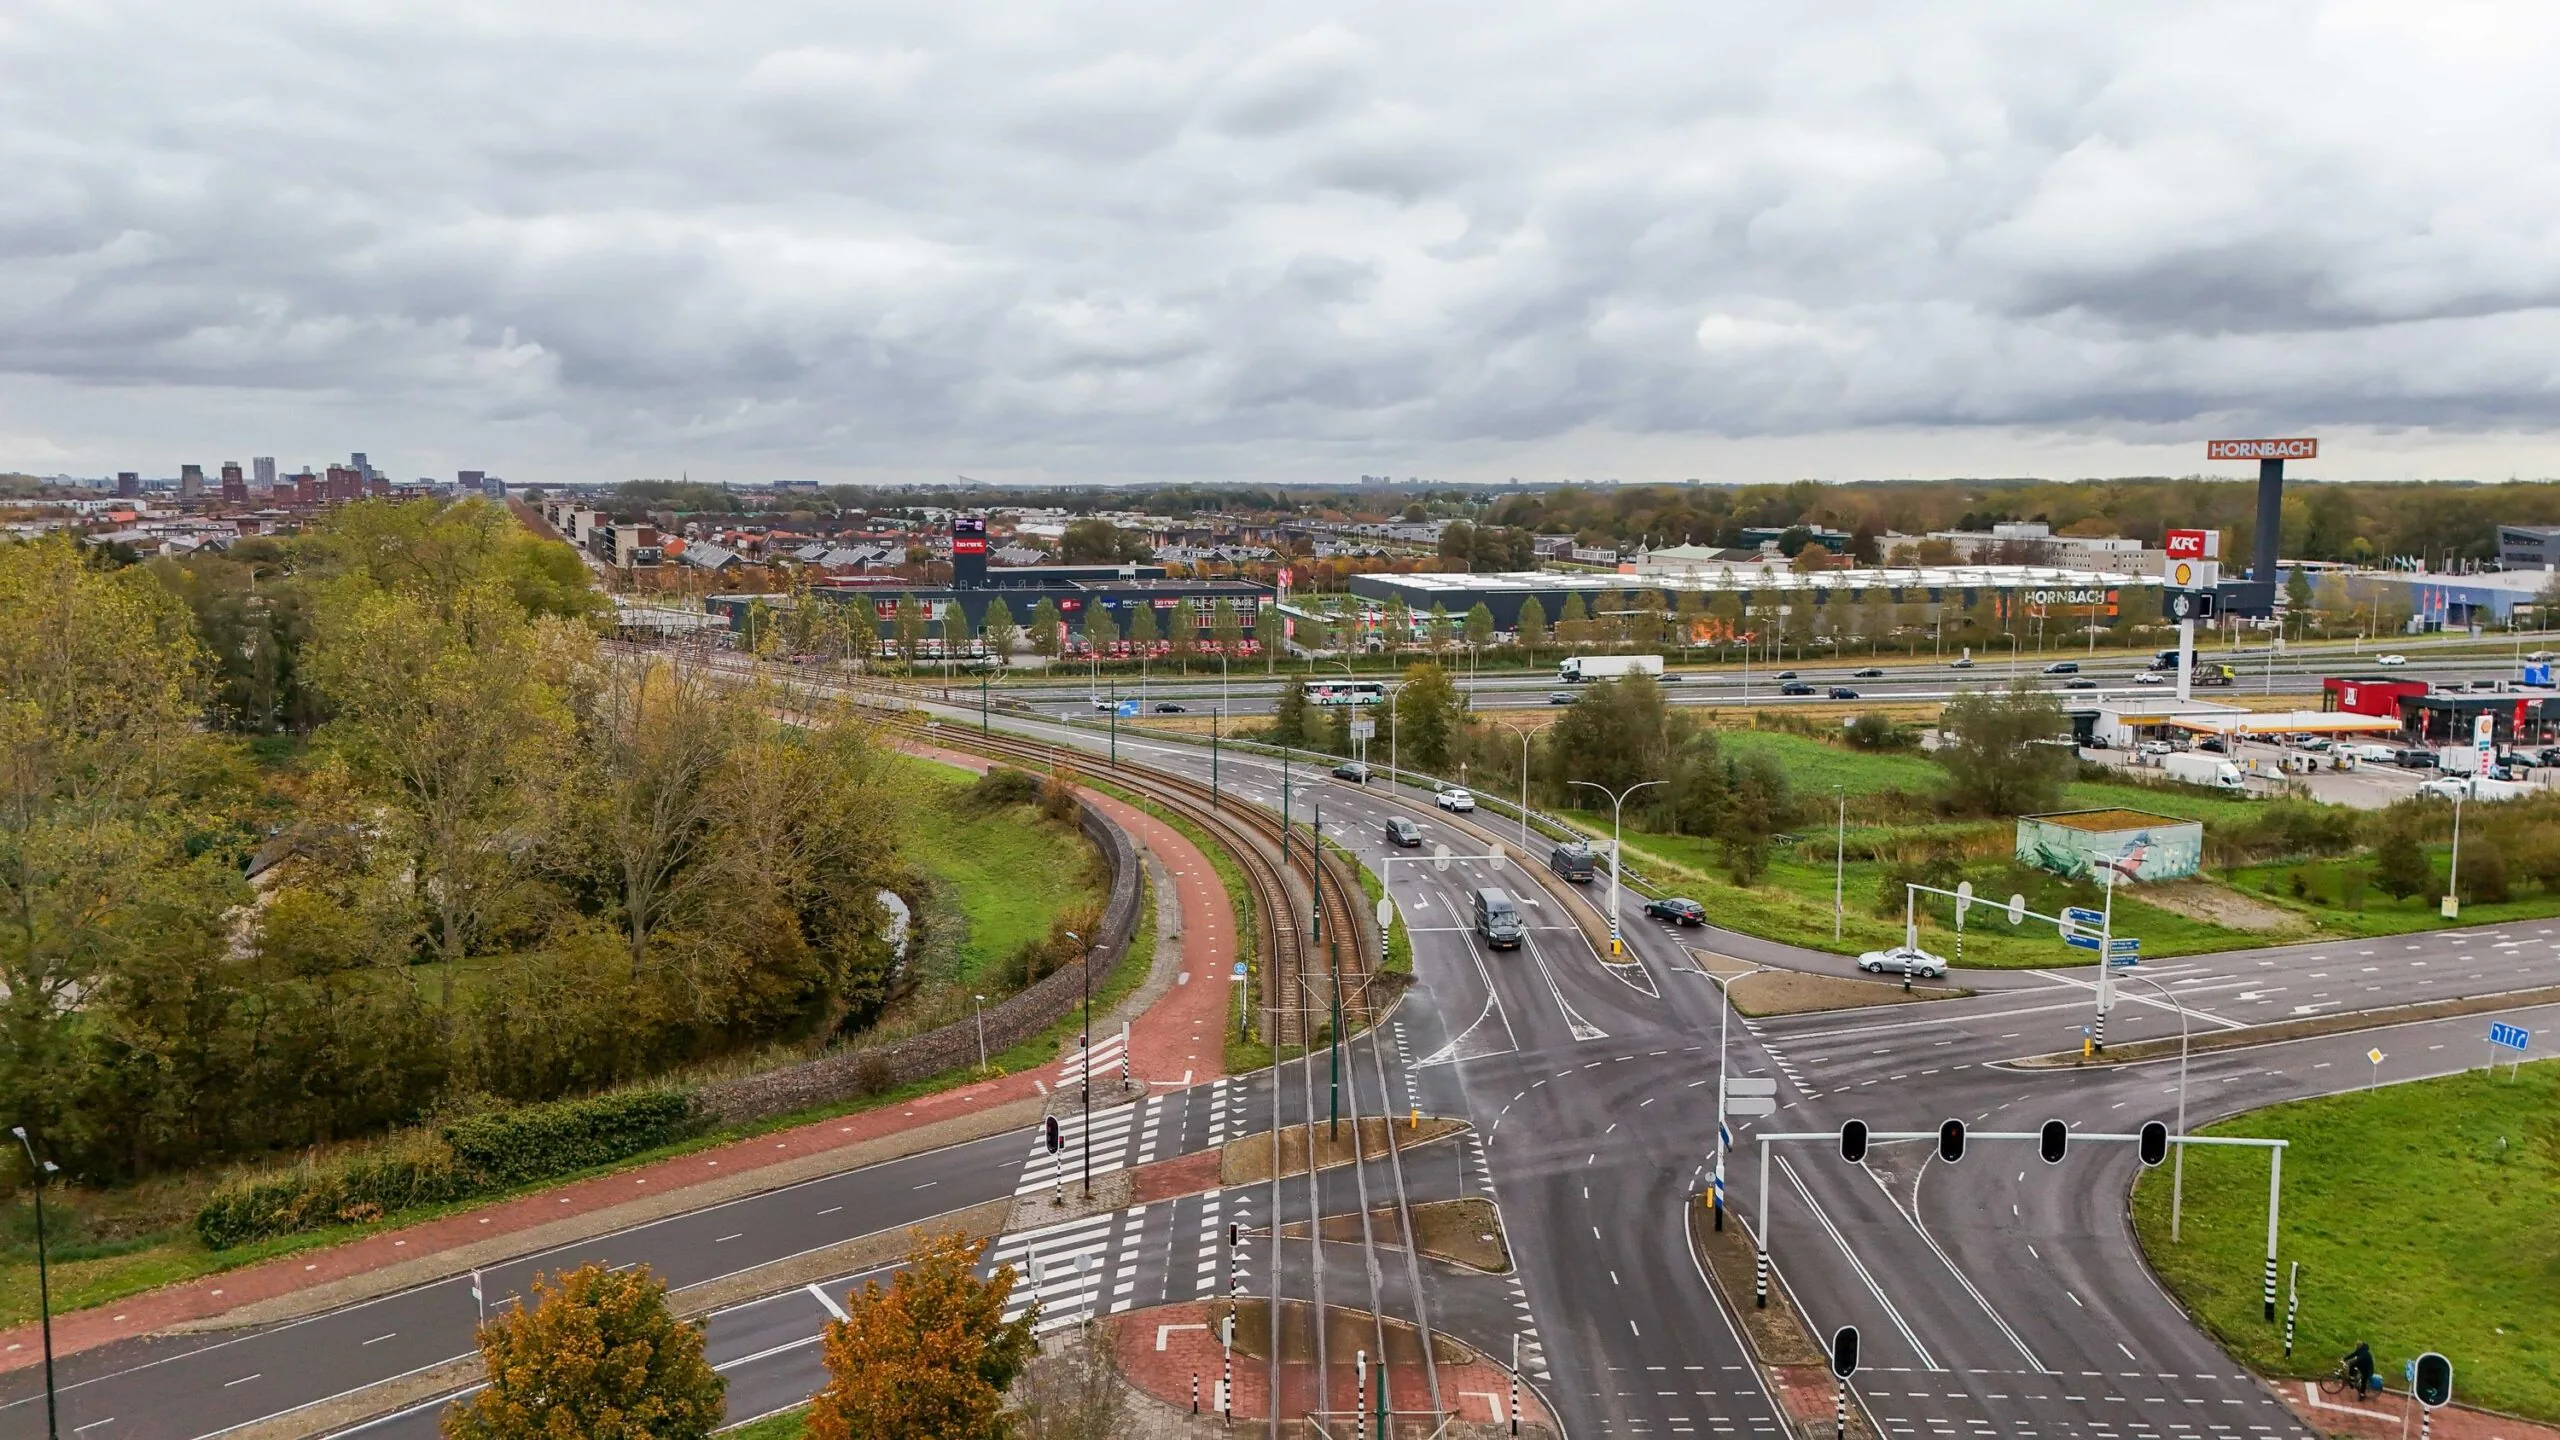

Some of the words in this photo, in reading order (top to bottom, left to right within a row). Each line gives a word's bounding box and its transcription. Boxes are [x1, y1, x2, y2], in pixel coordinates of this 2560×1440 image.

[2211, 441, 2313, 456] HORNBACH
[2169, 536, 2200, 550] KFC
[2025, 590, 2105, 604] HORNBACH
